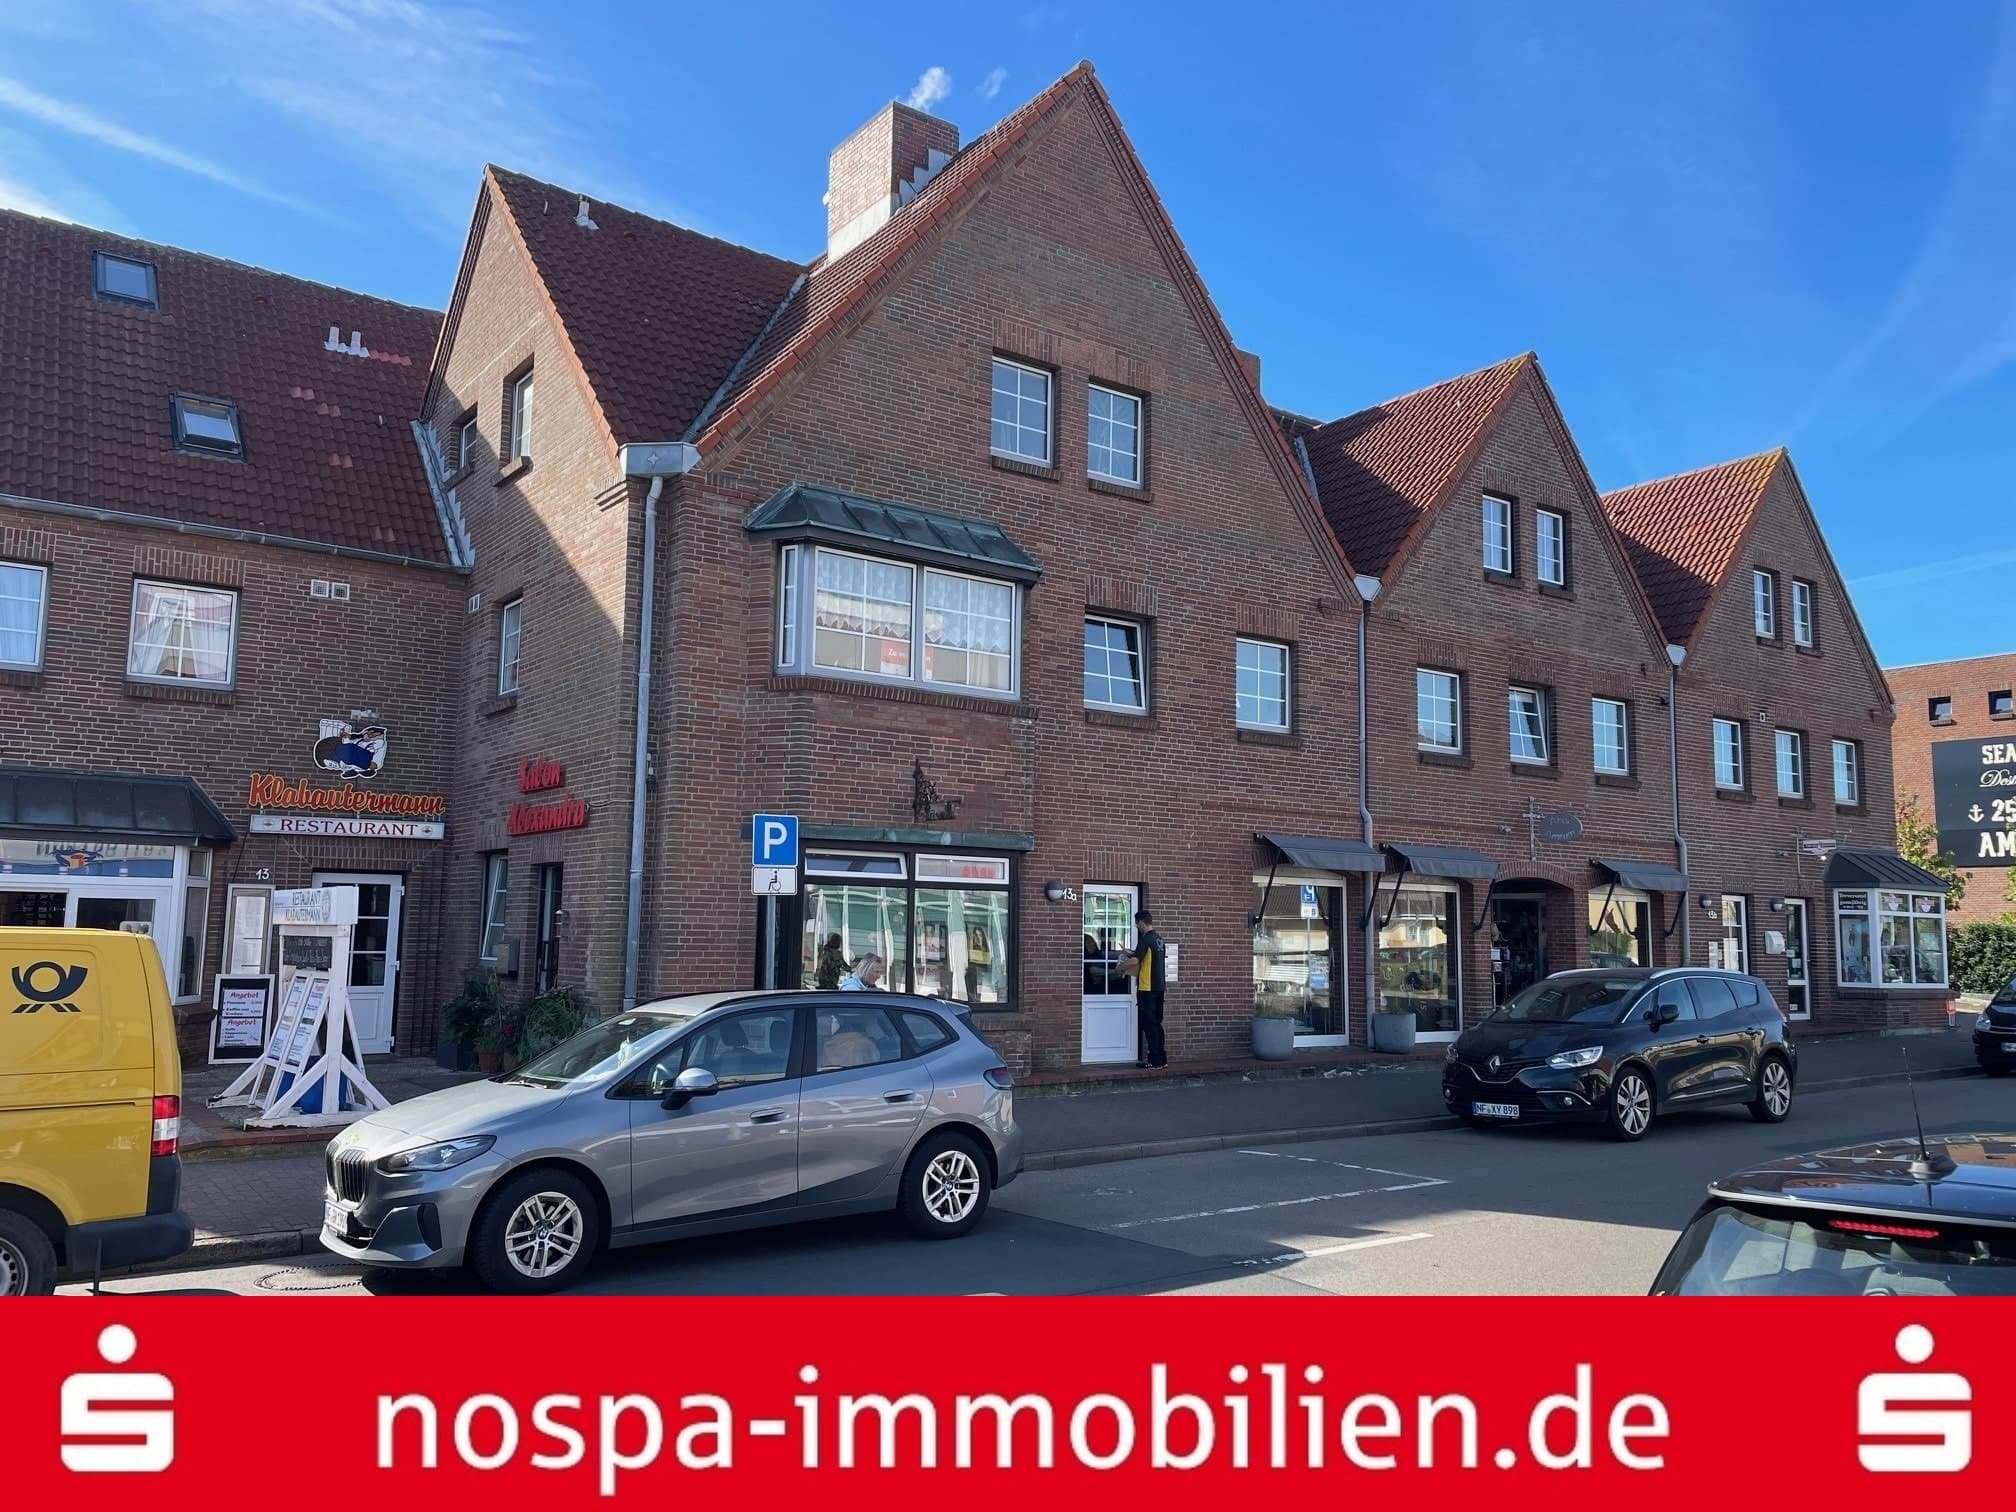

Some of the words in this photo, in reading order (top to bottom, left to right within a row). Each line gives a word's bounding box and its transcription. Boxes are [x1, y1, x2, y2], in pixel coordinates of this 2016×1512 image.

[249, 772, 445, 815] Klabautermann
[280, 819, 418, 836] RESTAURANT
[764, 821, 788, 859] P
[256, 868, 270, 881] 13
[1062, 887, 1077, 901] 13a
[1503, 1106, 1518, 1115] 898
